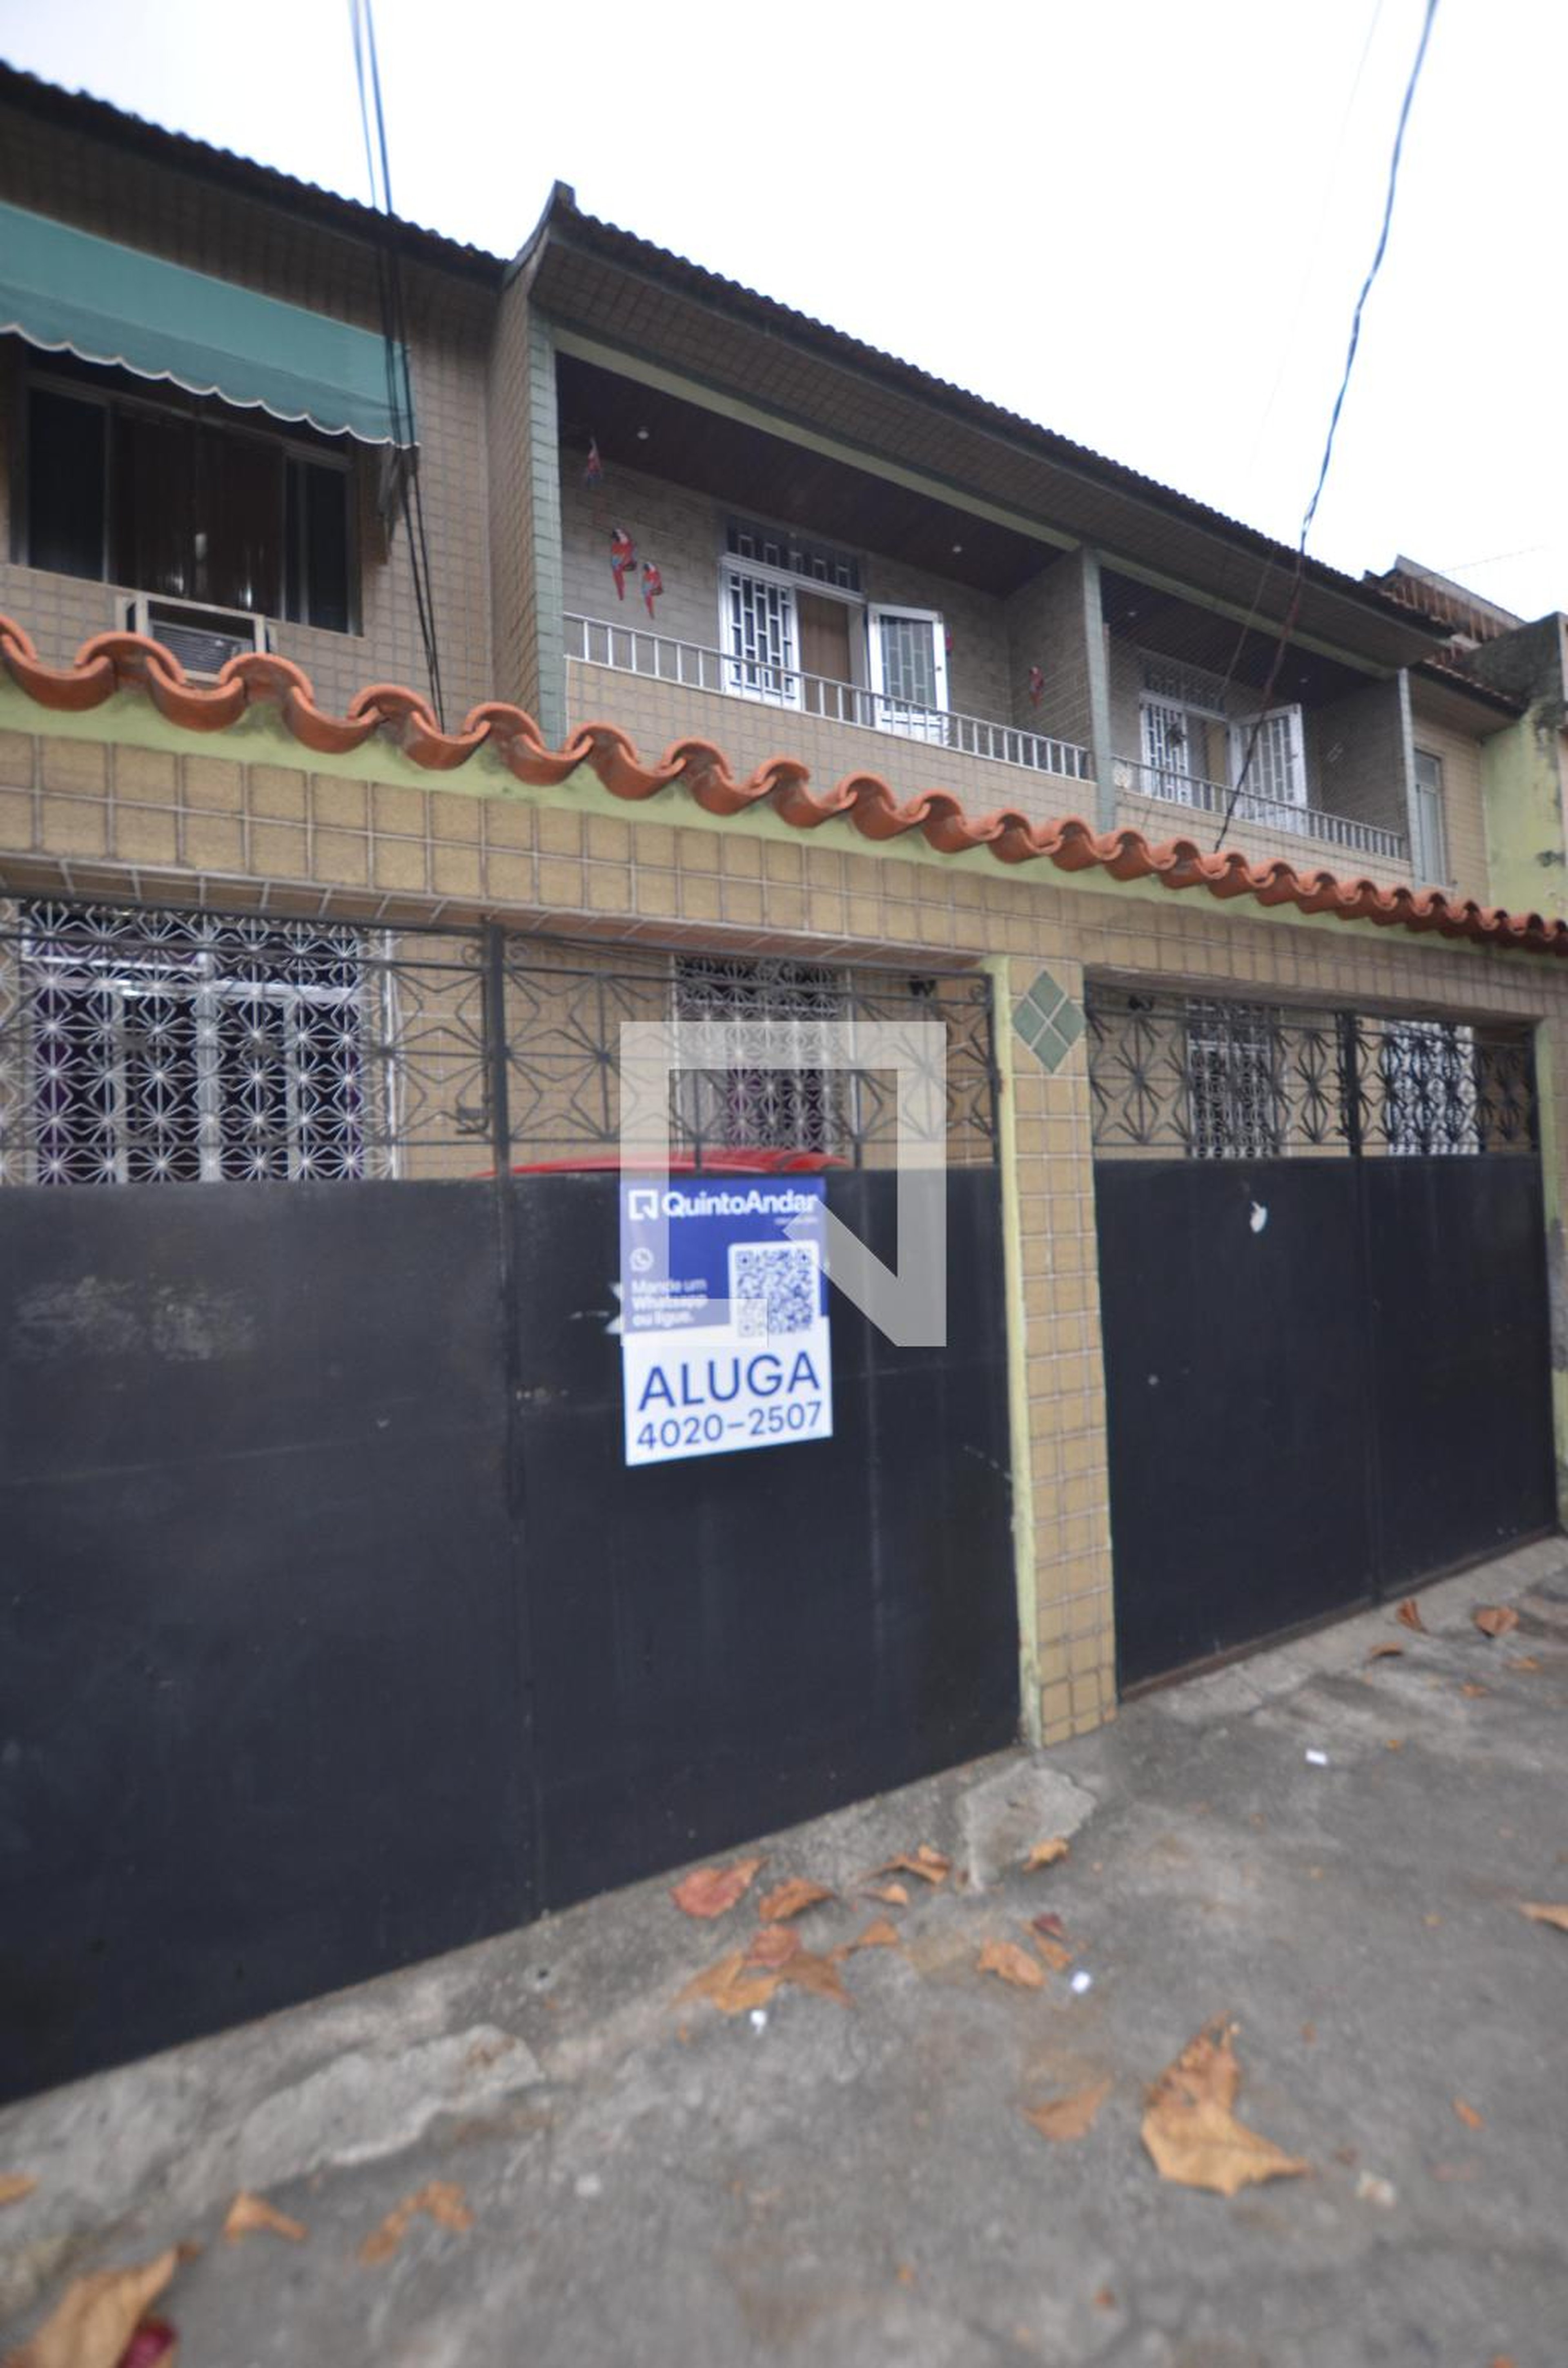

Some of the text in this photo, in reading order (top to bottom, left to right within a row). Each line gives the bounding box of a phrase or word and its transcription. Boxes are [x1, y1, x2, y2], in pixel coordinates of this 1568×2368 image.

[662, 1189, 817, 1217] QuintoAndar
[638, 1351, 820, 1411] ALUGA
[637, 1401, 822, 1449] 4020-2507
